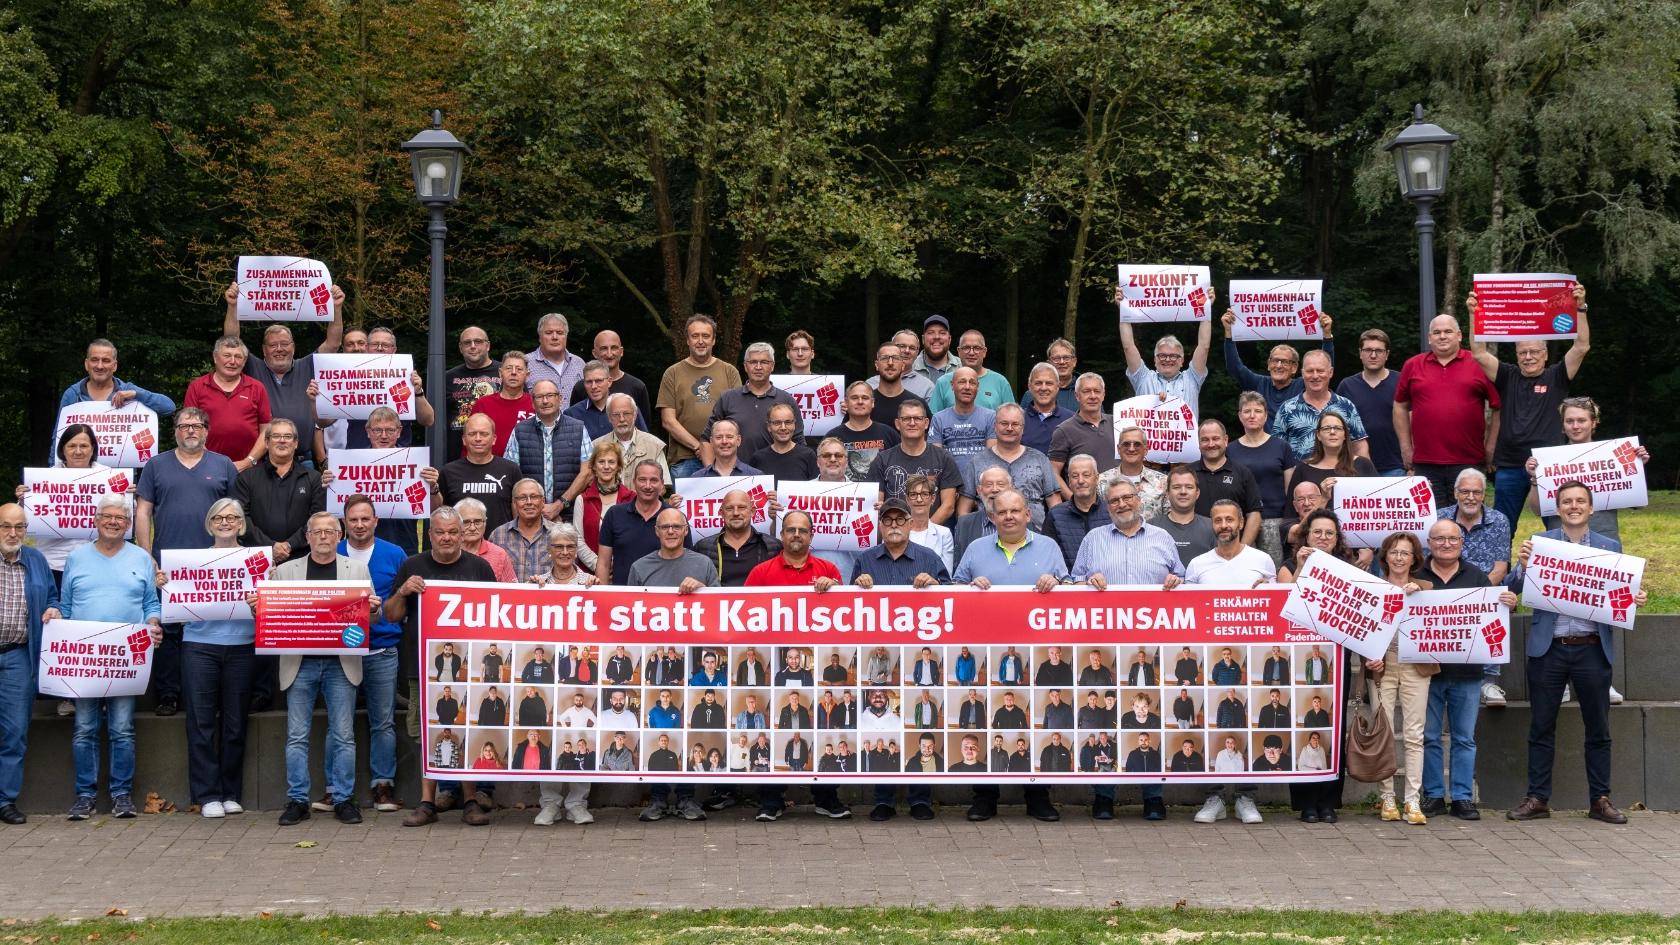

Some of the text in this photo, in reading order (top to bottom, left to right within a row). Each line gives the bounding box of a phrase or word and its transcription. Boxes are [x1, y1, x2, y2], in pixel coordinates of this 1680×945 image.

[246, 270, 322, 278] ZUSAMMENHALT
[1129, 274, 1198, 287] ZUKUNFT
[248, 289, 301, 300] STÄRKSTE
[1144, 287, 1180, 298] STATT
[1234, 293, 1315, 302] ZUSAMMENHALT
[254, 302, 296, 311] MARKE.
[1129, 299, 1186, 307] KAHLSCHLAG!
[1241, 304, 1294, 313] IST UNSERE
[1246, 314, 1296, 327] STÄRKE!
[319, 368, 407, 380] ZUSAMMENHALT
[327, 380, 385, 390] IST UNSERE
[332, 392, 388, 406] STÄRKE!
[66, 414, 150, 424] ZUSAMMENHALT
[1120, 408, 1180, 420] HÄNDE WEG
[1135, 419, 1152, 427] VON
[338, 464, 417, 480] ZUKUNFT
[1544, 459, 1615, 477] HÄNDE WEG
[1576, 471, 1622, 484] UNSEREN
[32, 481, 106, 494] HÄNDE WEG
[355, 481, 396, 493] STATT
[462, 482, 496, 493] PUMA
[49, 495, 92, 503] VON DER
[788, 495, 866, 512] ZUKUNFT
[1343, 496, 1410, 509] HÄNDE WEG
[34, 505, 98, 516] 35-STUND
[1350, 511, 1415, 520] VON UNSEREN
[58, 518, 96, 528] WOCH
[1342, 520, 1424, 531] ARBEITSPLÄTZEN!
[171, 567, 245, 580] HÄNDE WEG
[1533, 554, 1634, 583] ZUSAMMENHALT
[194, 580, 243, 590] VON DER
[1539, 569, 1605, 590] IST UNSERE
[1309, 566, 1380, 607] HÄNDE WEG
[1214, 596, 1270, 608] ERKÄMPFT
[1320, 584, 1362, 610] VON DER
[1542, 584, 1606, 608] STÄRKE!
[1300, 588, 1382, 632] 35-STUNDEN-
[1409, 603, 1499, 616] ZUSAMMENHALT
[437, 594, 954, 640] Zukunft statt Kahlschlag!
[1028, 607, 1196, 630] GEMEINSAM
[1214, 612, 1268, 622] ERHALTEN
[1423, 616, 1481, 626] IST UNSERE
[1214, 626, 1274, 636] GESTALTEN
[1318, 610, 1368, 641] WOCHE!
[1410, 627, 1472, 640] STÄRKSTE
[50, 640, 126, 656] HÄNDE WEG
[1418, 642, 1466, 652] MARKE.
[58, 656, 129, 667] VON UNSEREN
[47, 667, 137, 678] ARBEITSPLÄTZEN!
